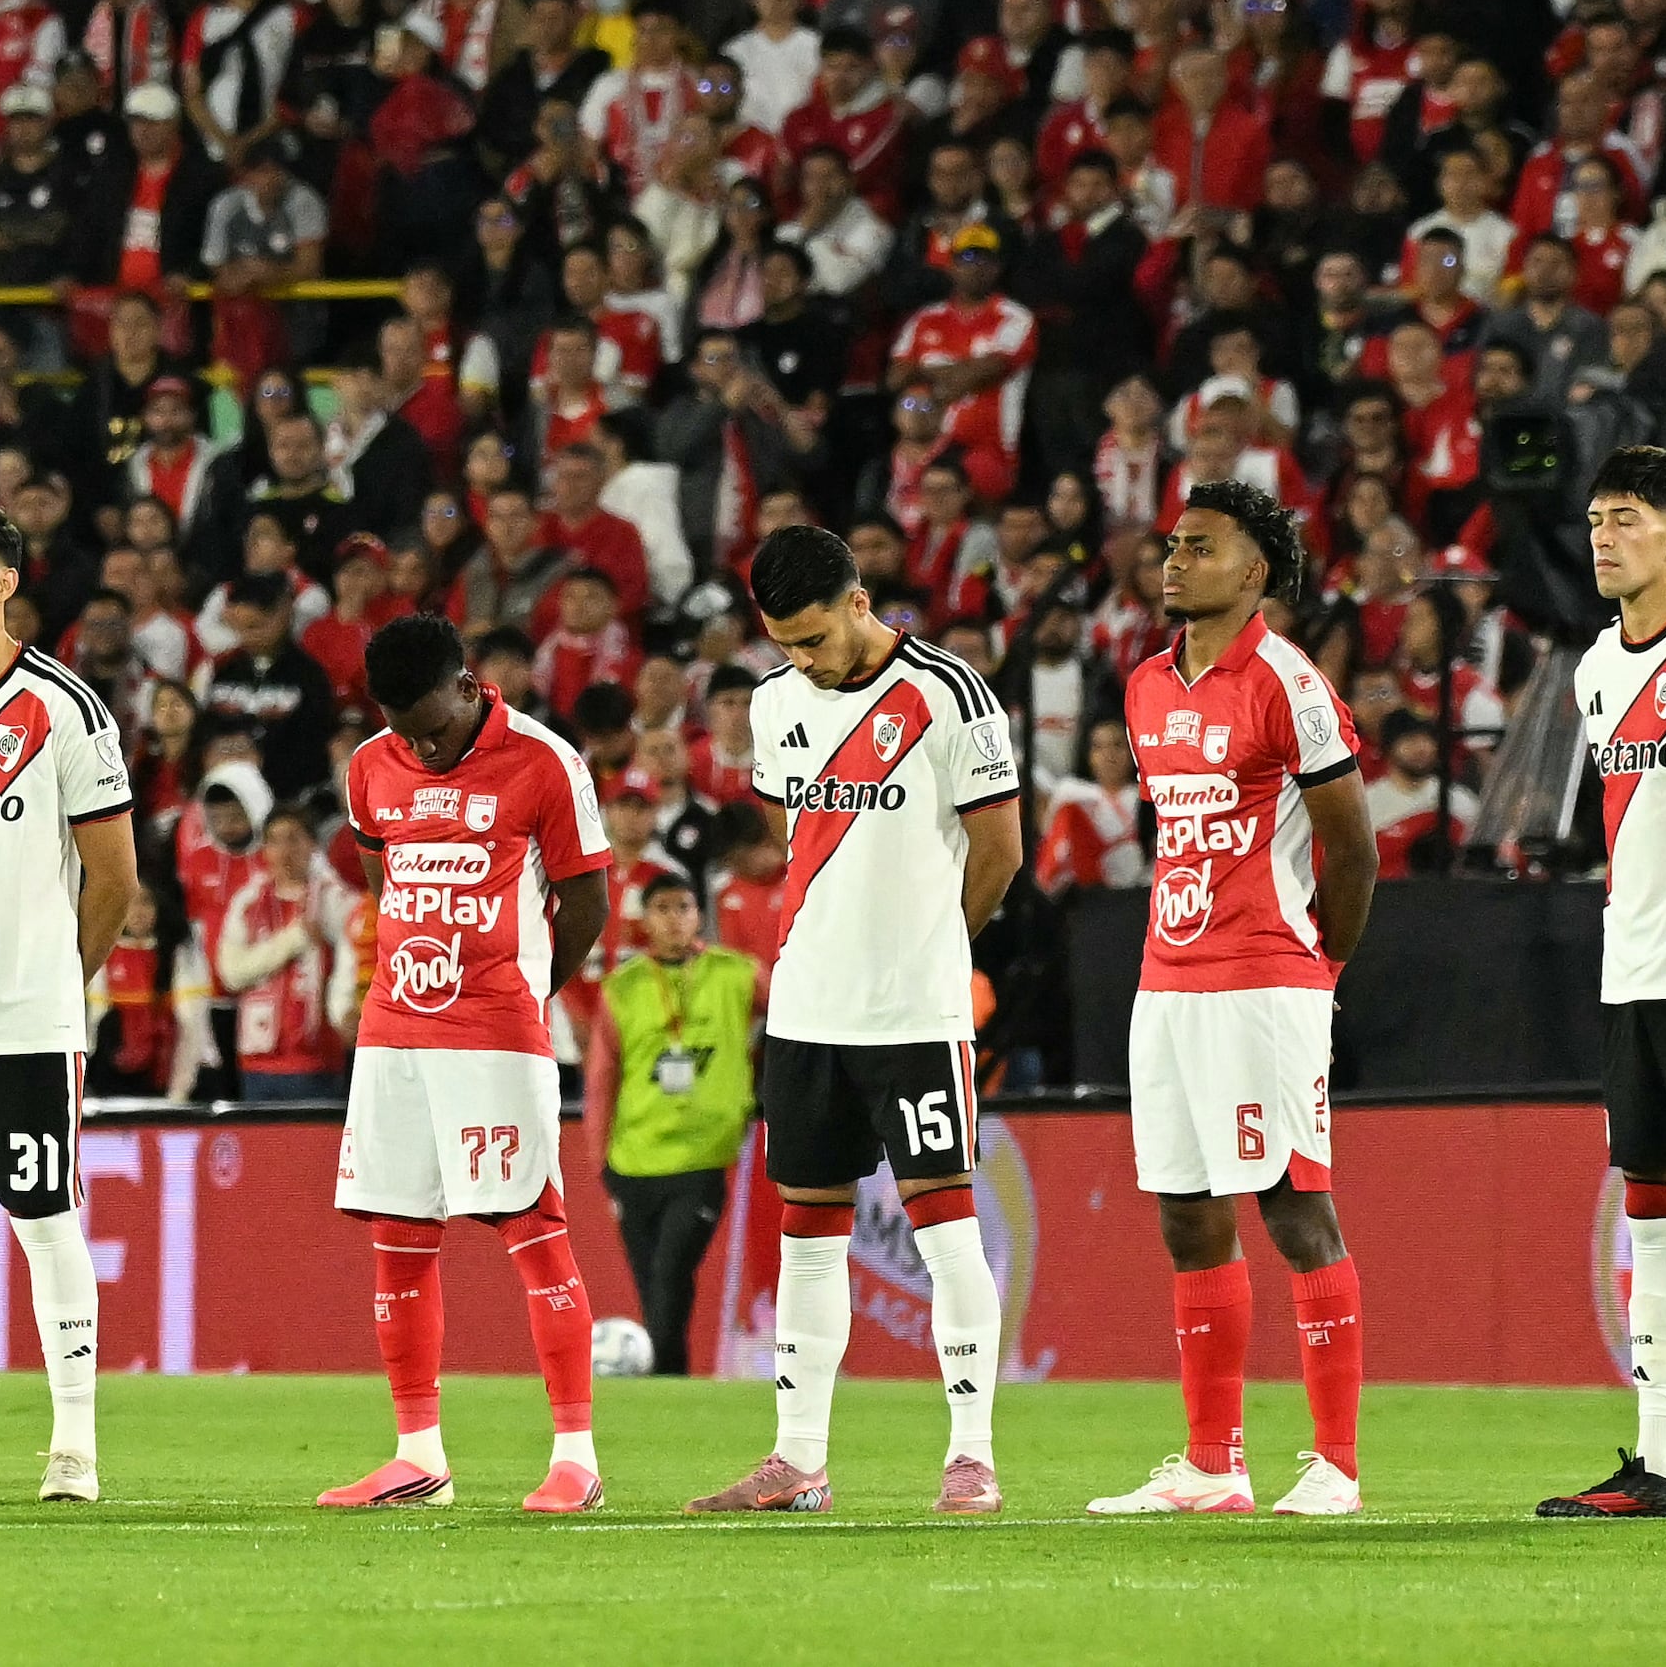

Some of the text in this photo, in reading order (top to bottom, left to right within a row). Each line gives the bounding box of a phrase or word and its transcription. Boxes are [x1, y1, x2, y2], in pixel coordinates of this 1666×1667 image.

[1138, 734, 1158, 747] FILA
[415, 800, 455, 813] AGUILA
[787, 776, 906, 810] Betano
[376, 808, 403, 821] FILA
[389, 850, 486, 874] Colanta
[380, 879, 503, 933] BetPlay
[391, 932, 464, 1002] Pool
[1314, 1075, 1326, 1133] FILA
[898, 1090, 954, 1155] 15
[1236, 1103, 1265, 1160] 6
[10, 1132, 59, 1191] 31
[59, 1318, 92, 1331] RIVER
[944, 1343, 978, 1356] RIVER
